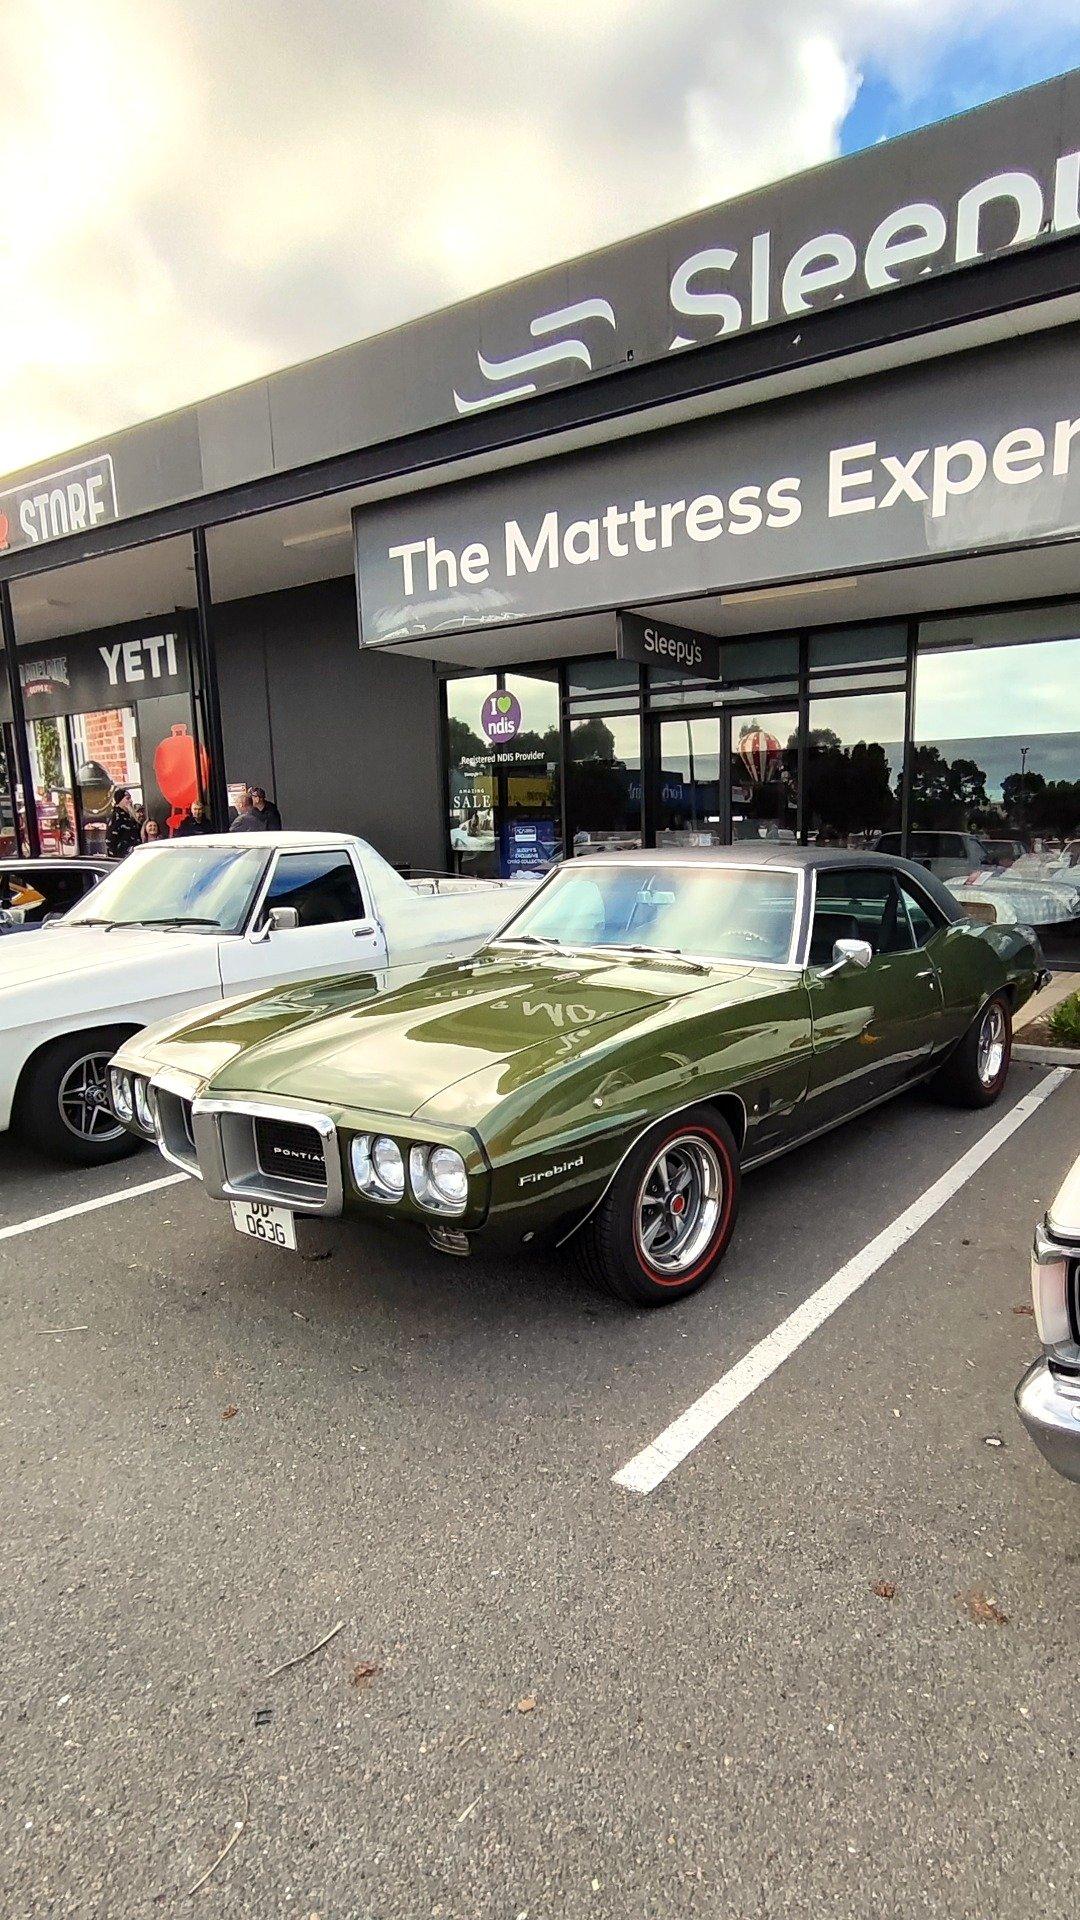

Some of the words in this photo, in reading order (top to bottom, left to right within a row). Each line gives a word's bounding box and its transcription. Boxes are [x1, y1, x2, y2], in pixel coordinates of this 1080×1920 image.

[388, 536, 491, 596] The
[504, 474, 802, 577] Mattress
[827, 418, 1080, 519] Exper
[99, 633, 178, 685] YETI
[644, 628, 702, 666] Sleepy's
[489, 698, 498, 716] I
[488, 717, 516, 735] ndis
[460, 753, 496, 765] Registered
[497, 752, 514, 763] NDIS
[515, 750, 545, 761] Provider
[453, 795, 491, 809] SALE
[517, 1155, 584, 1187] Firebird
